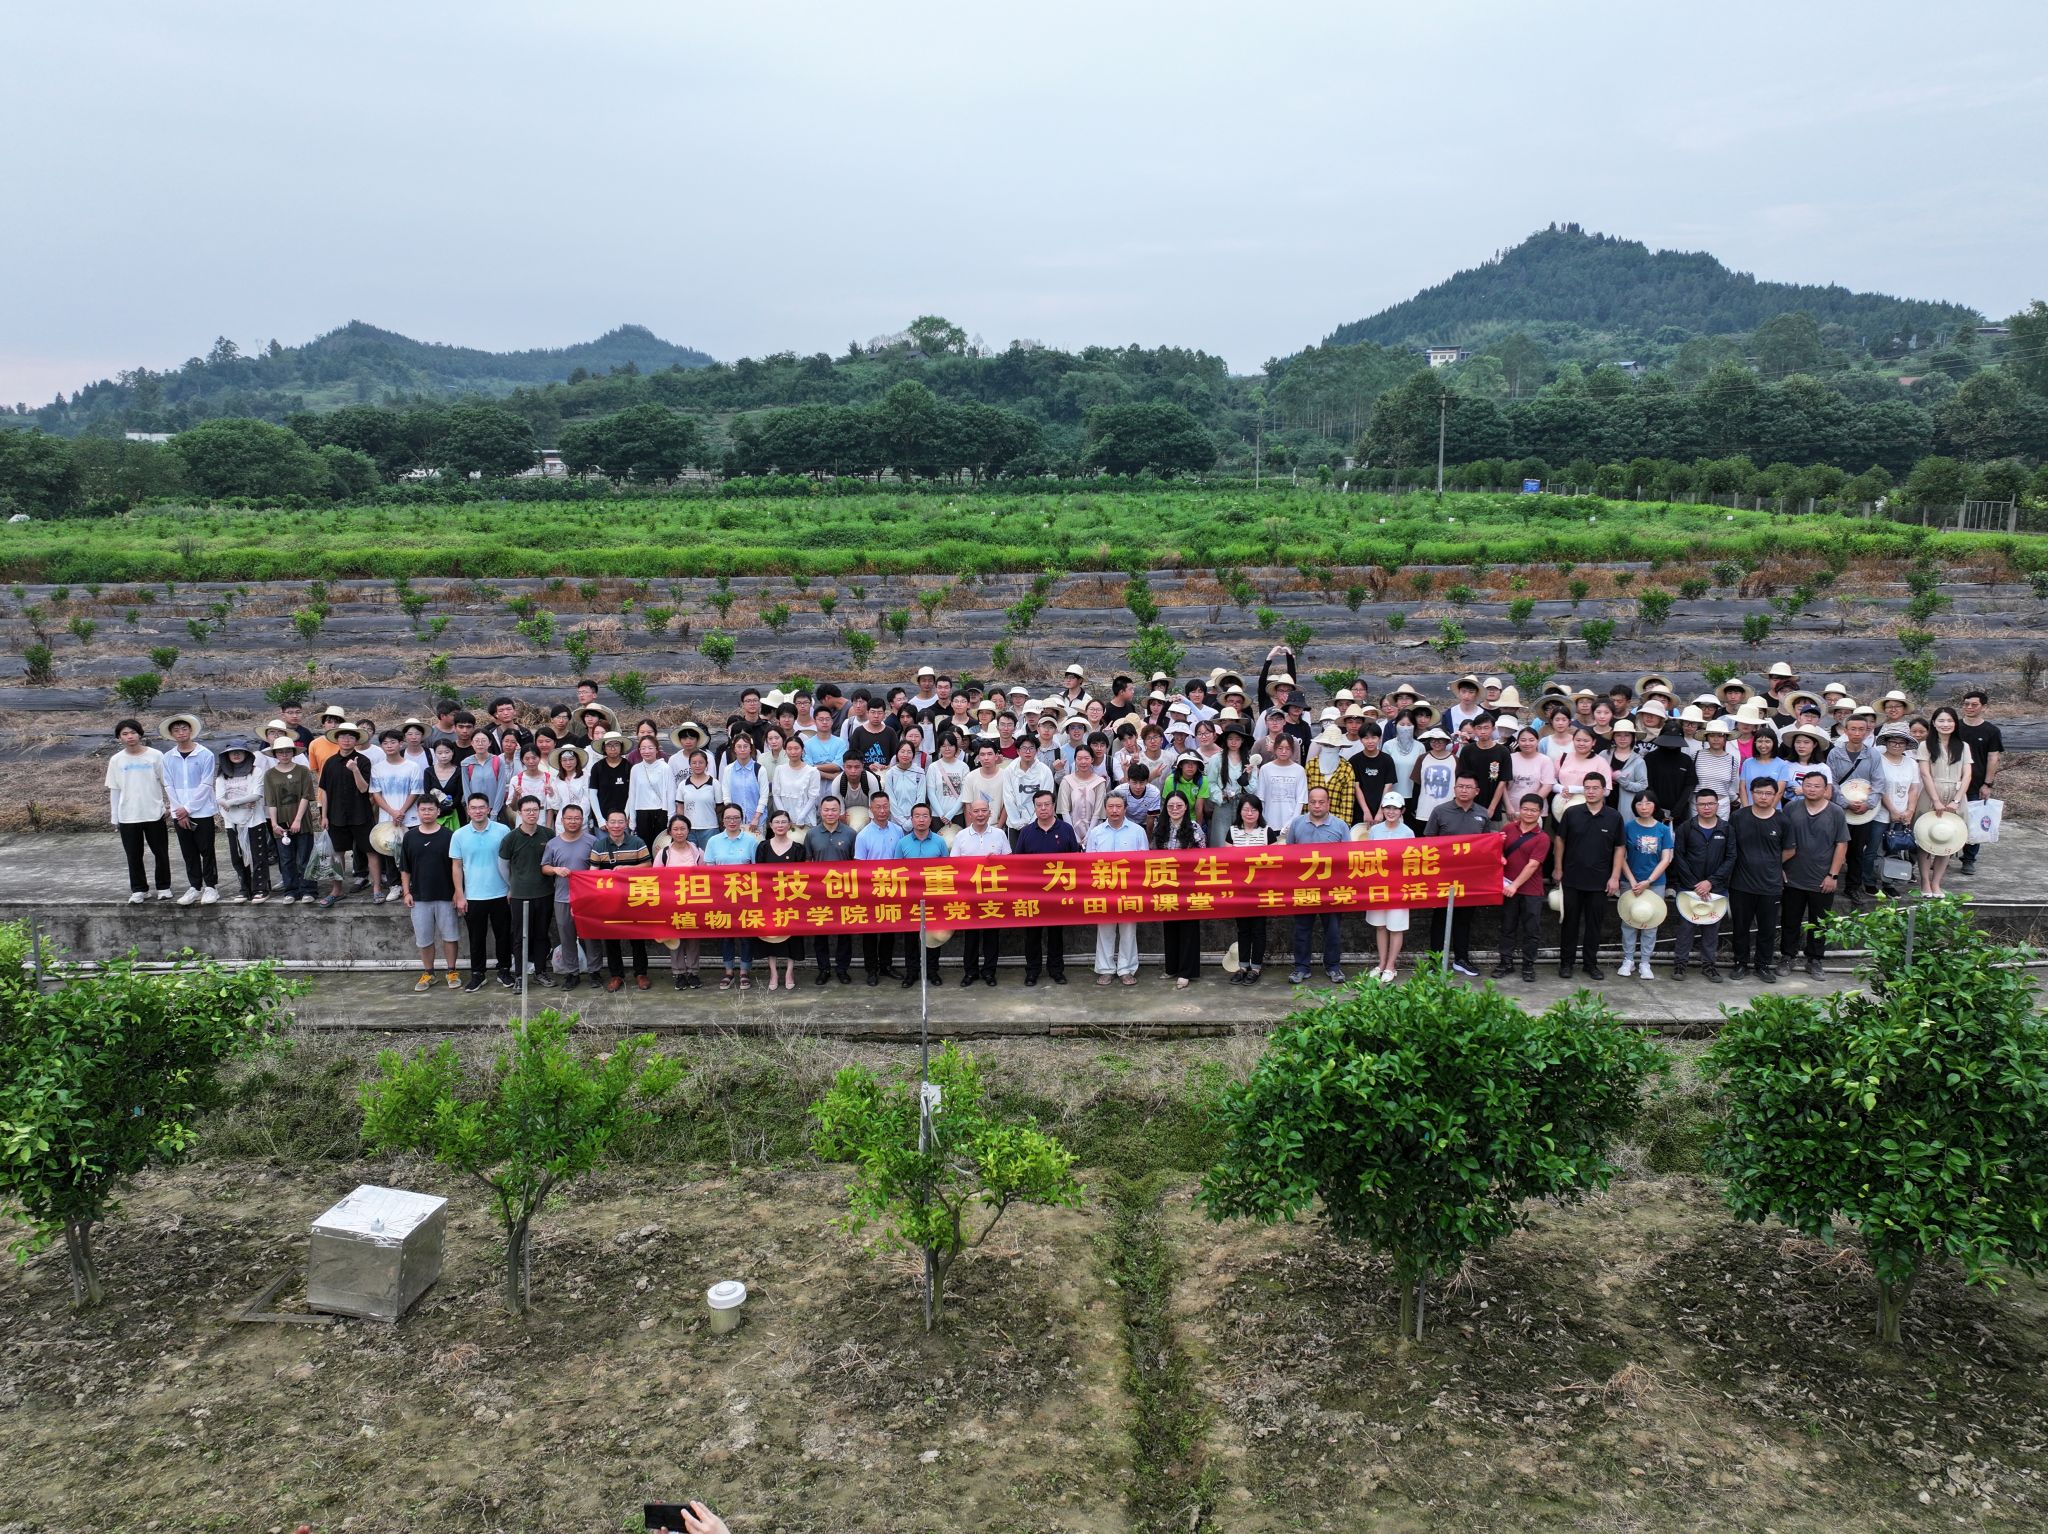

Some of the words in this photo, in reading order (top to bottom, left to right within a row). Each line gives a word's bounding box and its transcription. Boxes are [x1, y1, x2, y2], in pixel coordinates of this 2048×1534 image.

[596, 863, 1009, 907] “勇担科技创新重任
[1042, 842, 1472, 892] 为新质生产力赋能”
